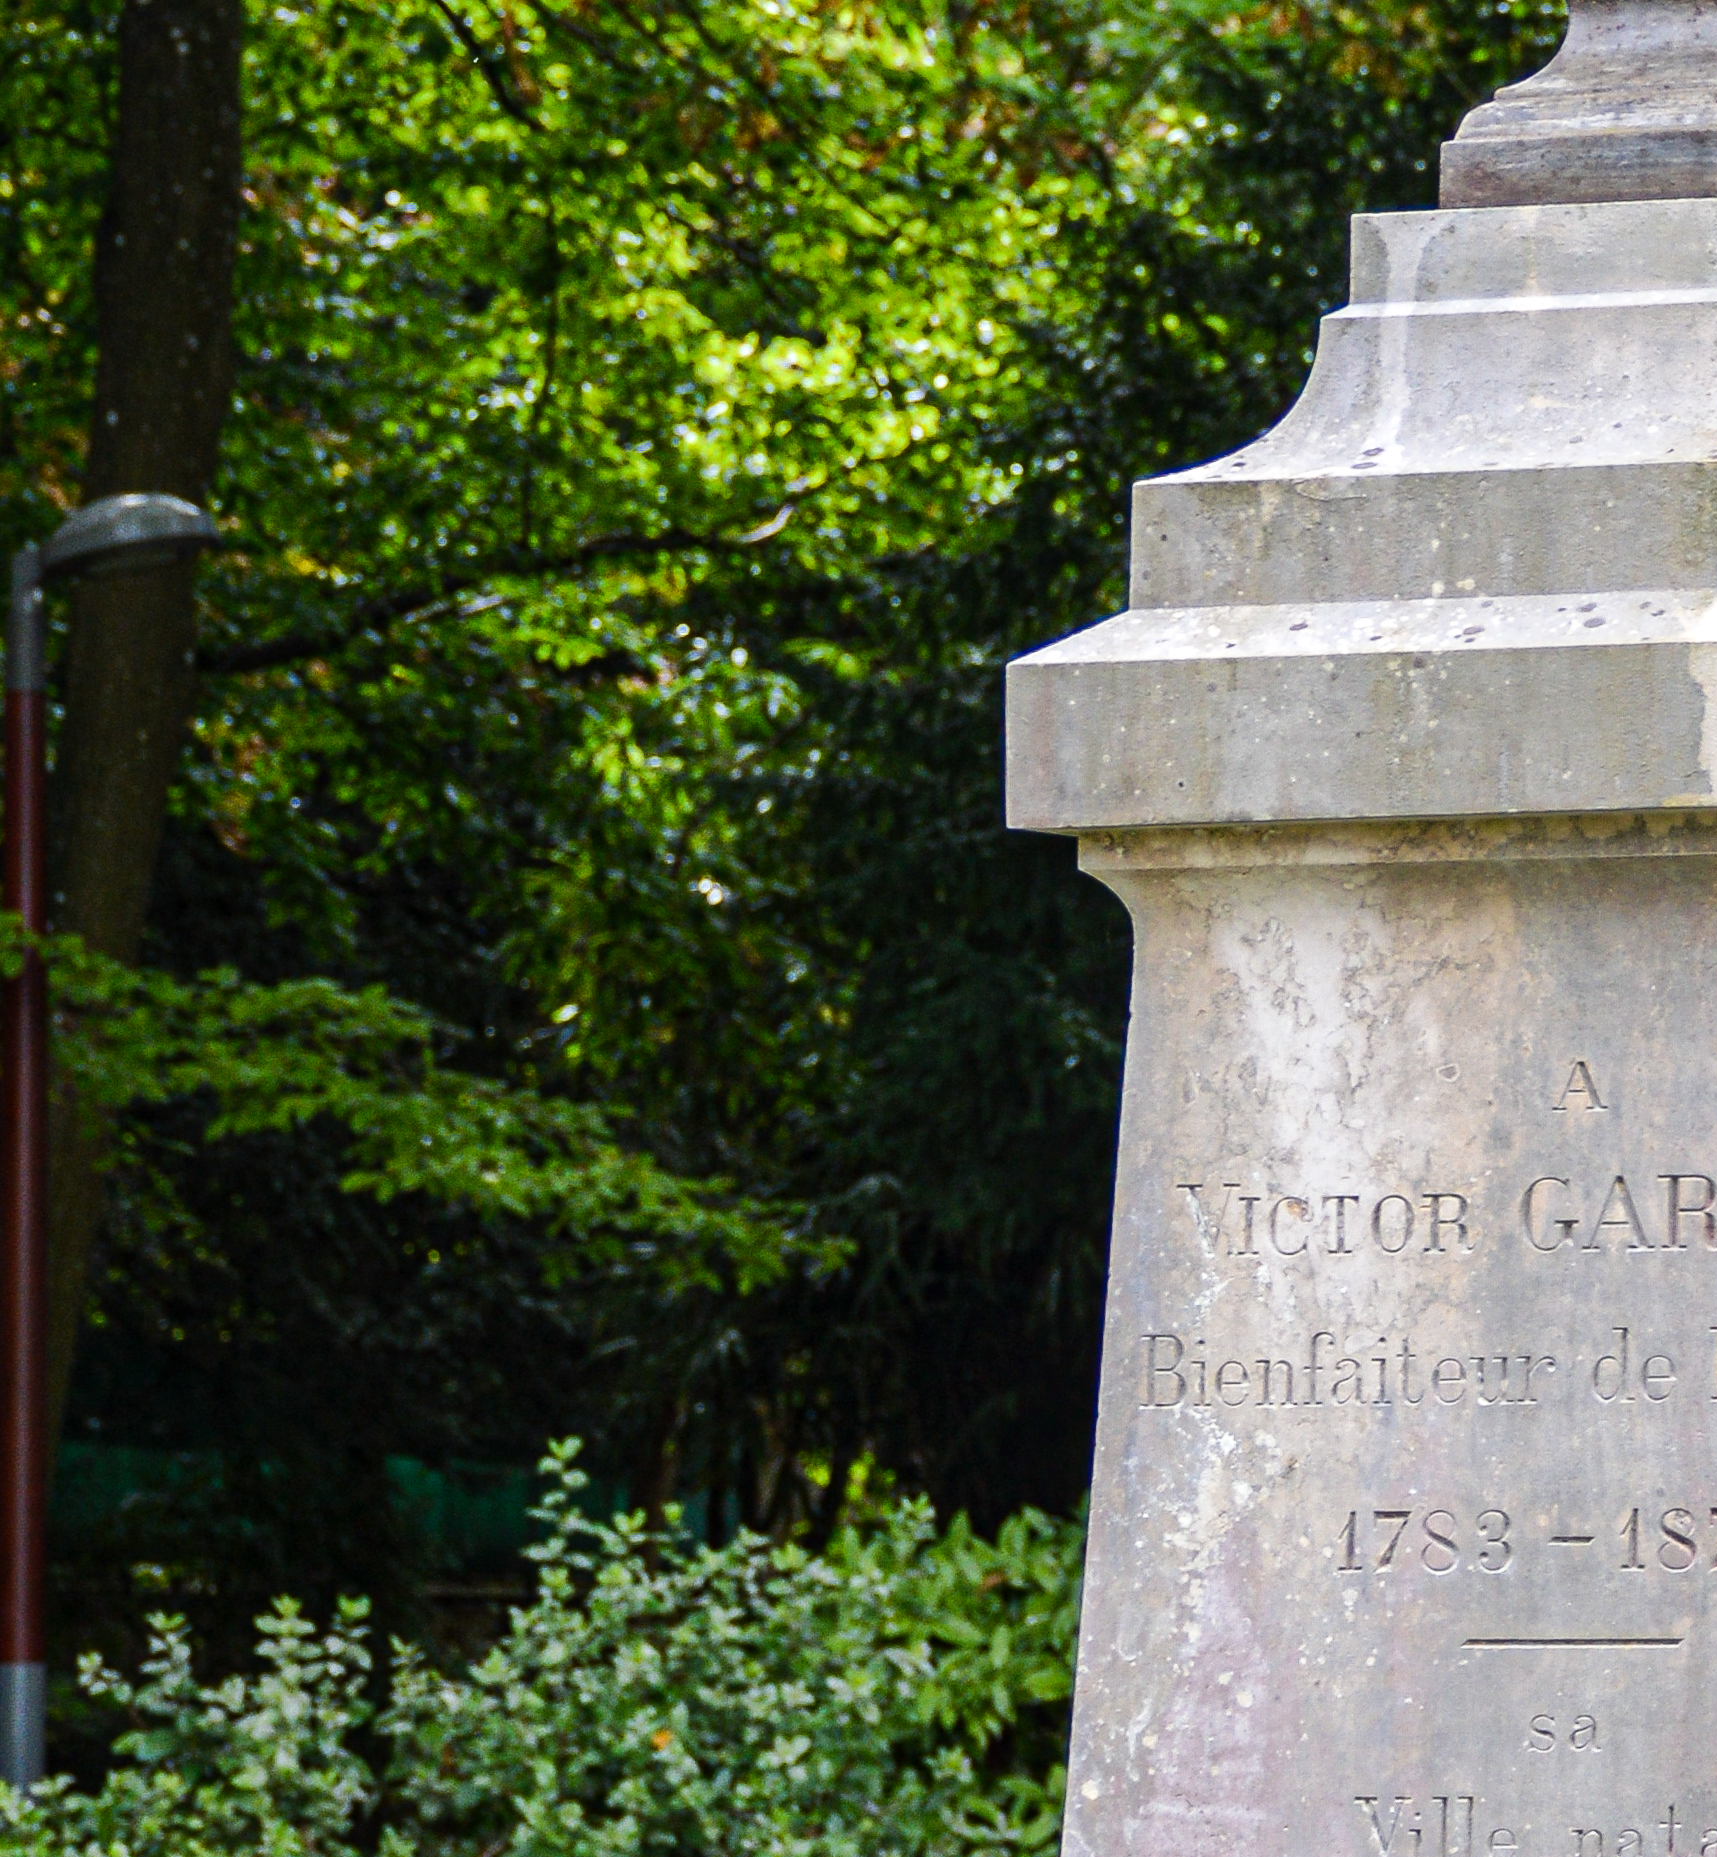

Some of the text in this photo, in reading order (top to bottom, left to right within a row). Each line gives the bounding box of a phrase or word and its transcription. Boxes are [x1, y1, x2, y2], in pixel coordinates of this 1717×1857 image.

[1552, 1060, 1608, 1114] A
[1177, 1183, 1475, 1258] VICTOR
[1139, 1331, 1557, 1411] Bienfaiteur
[1593, 1327, 1677, 1405] de
[1335, 1507, 1514, 1577] 1783
[1525, 1711, 1603, 1755] sa
